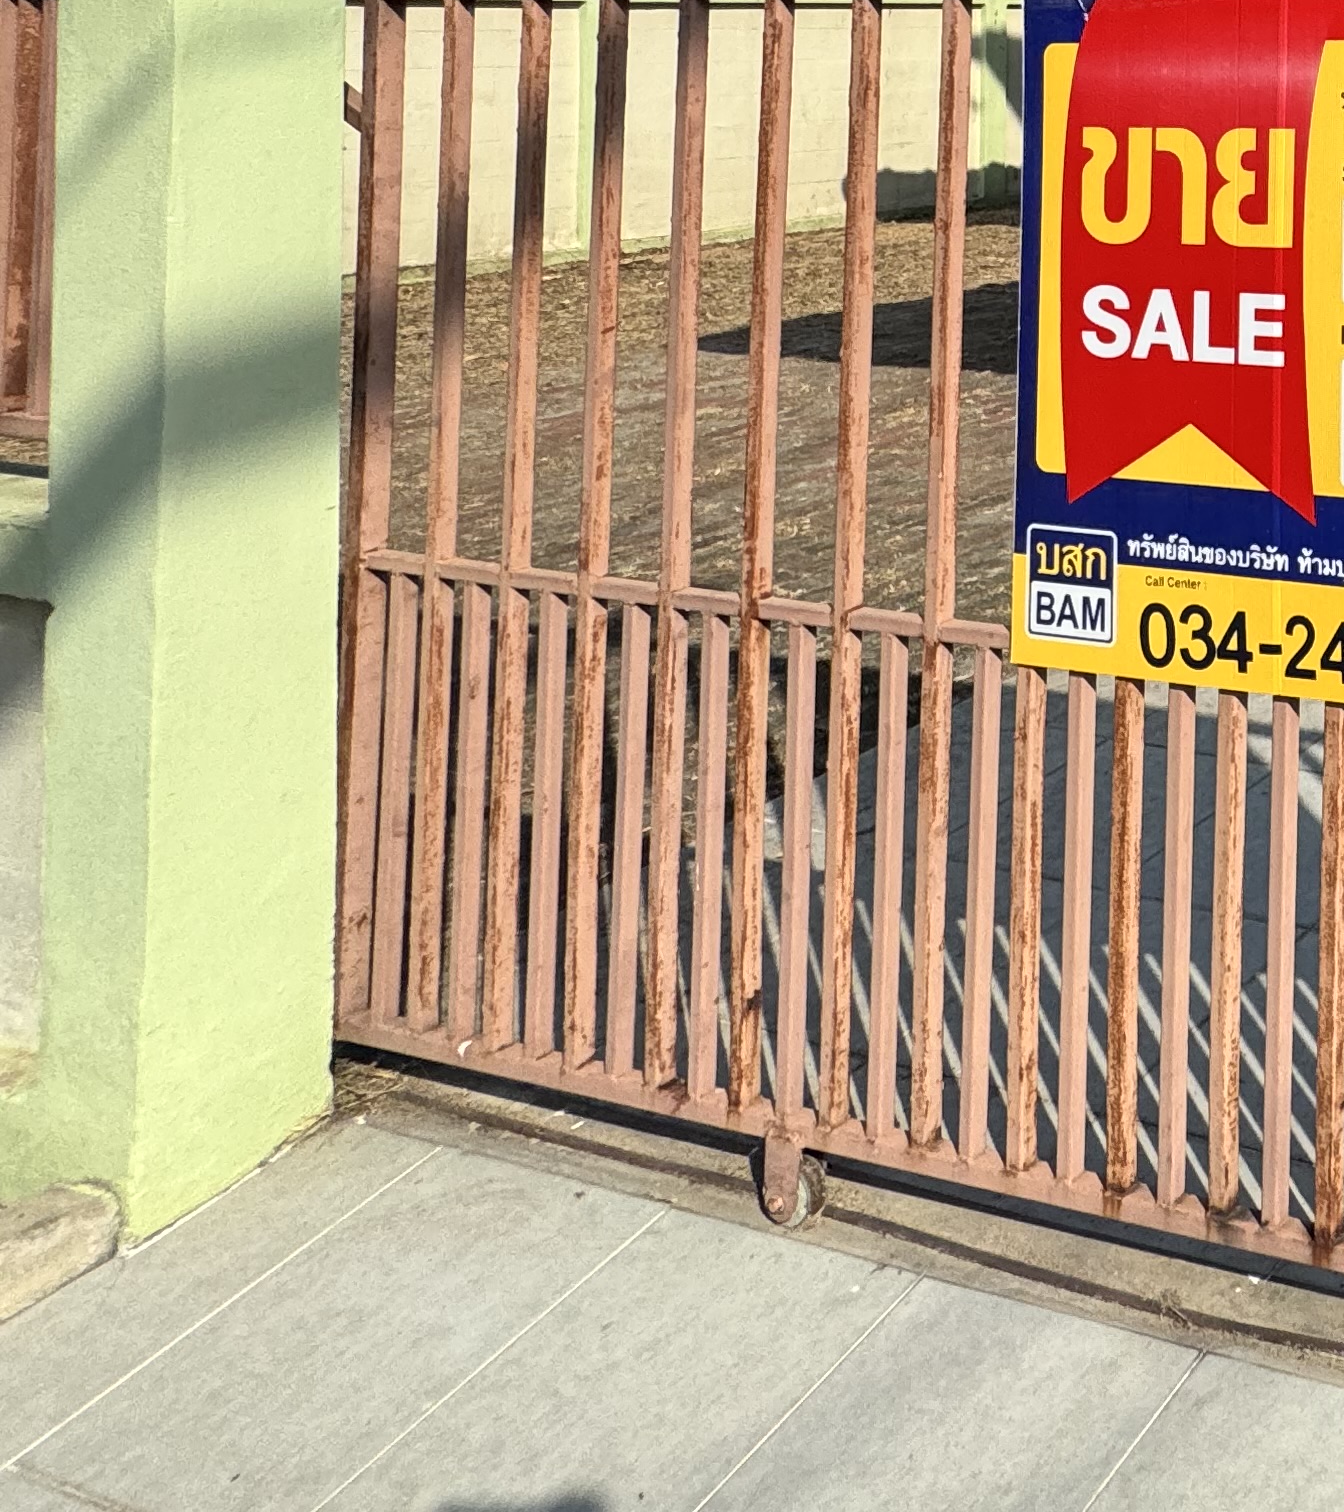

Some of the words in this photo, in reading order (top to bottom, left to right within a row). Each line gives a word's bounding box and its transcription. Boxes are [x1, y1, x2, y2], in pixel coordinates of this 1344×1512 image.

[1081, 126, 1296, 249] ขาย
[1081, 284, 1286, 367] SALE
[1036, 541, 1107, 581] บสก
[1127, 533, 1290, 573] ทรัพย์สินของบริษัท
[1145, 575, 1165, 587] Call
[1035, 590, 1106, 633] BAM
